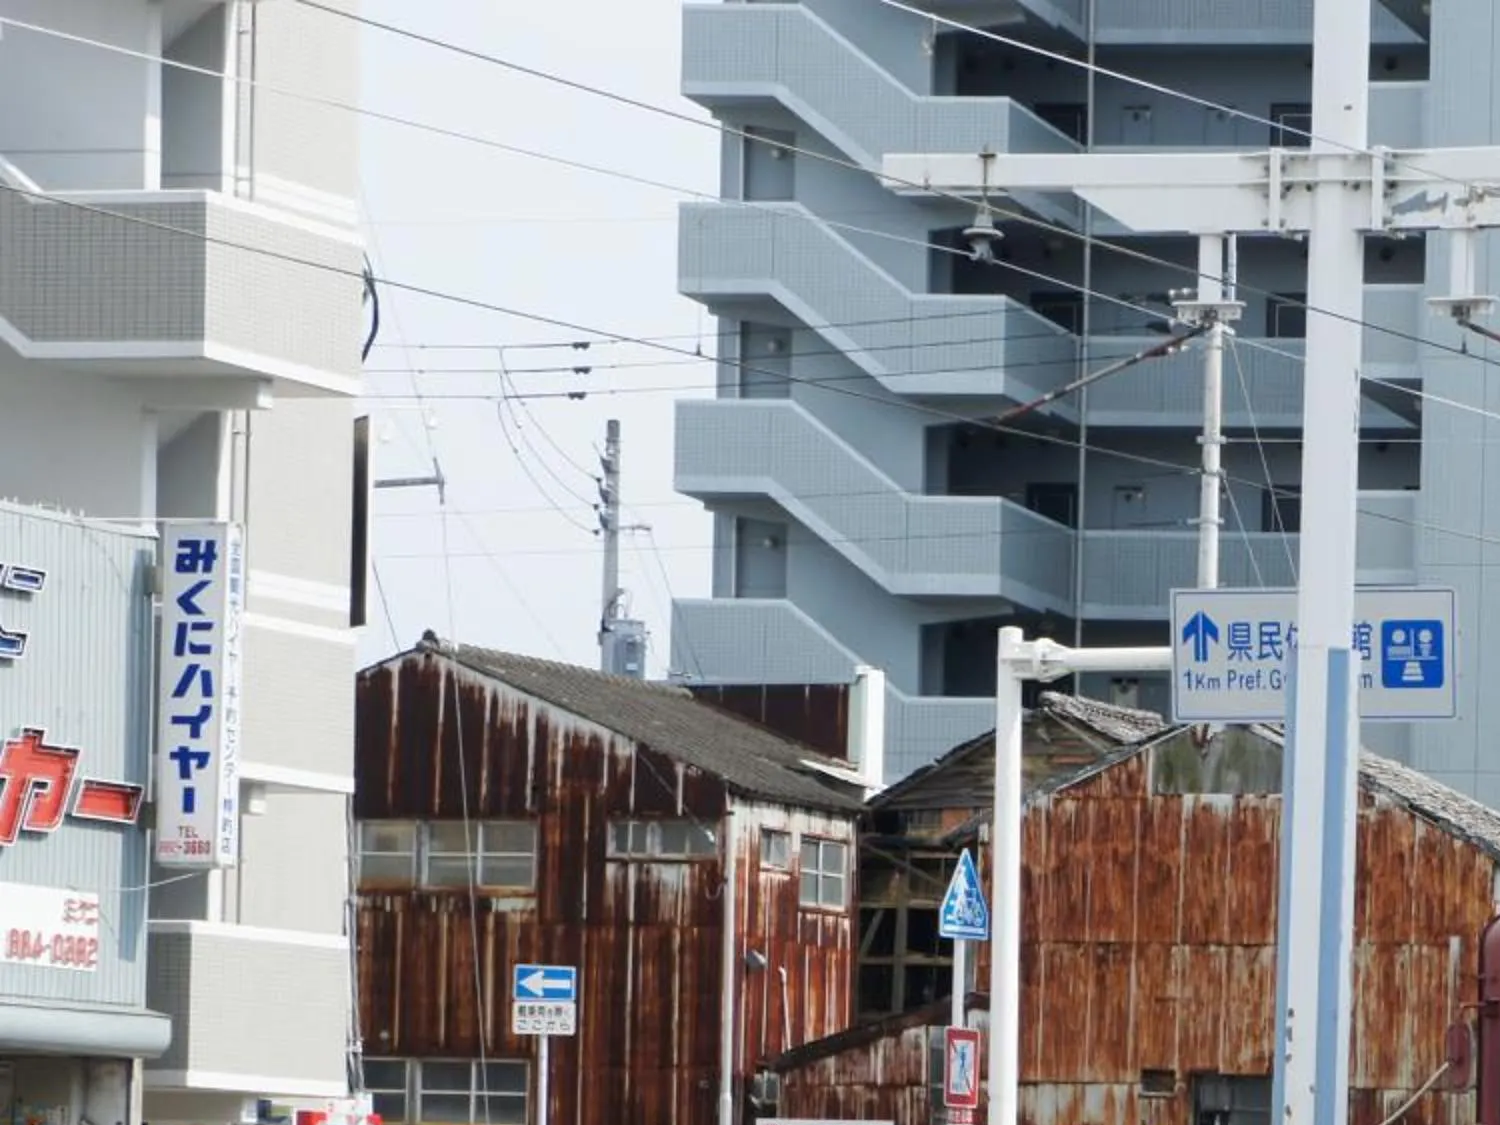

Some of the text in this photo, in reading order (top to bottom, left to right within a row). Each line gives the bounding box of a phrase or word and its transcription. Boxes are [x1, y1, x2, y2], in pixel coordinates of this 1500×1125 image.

[1227, 621, 1372, 660] 県民館
[170, 539, 217, 813] みくにハイヤー
[177, 825, 198, 838] TEL
